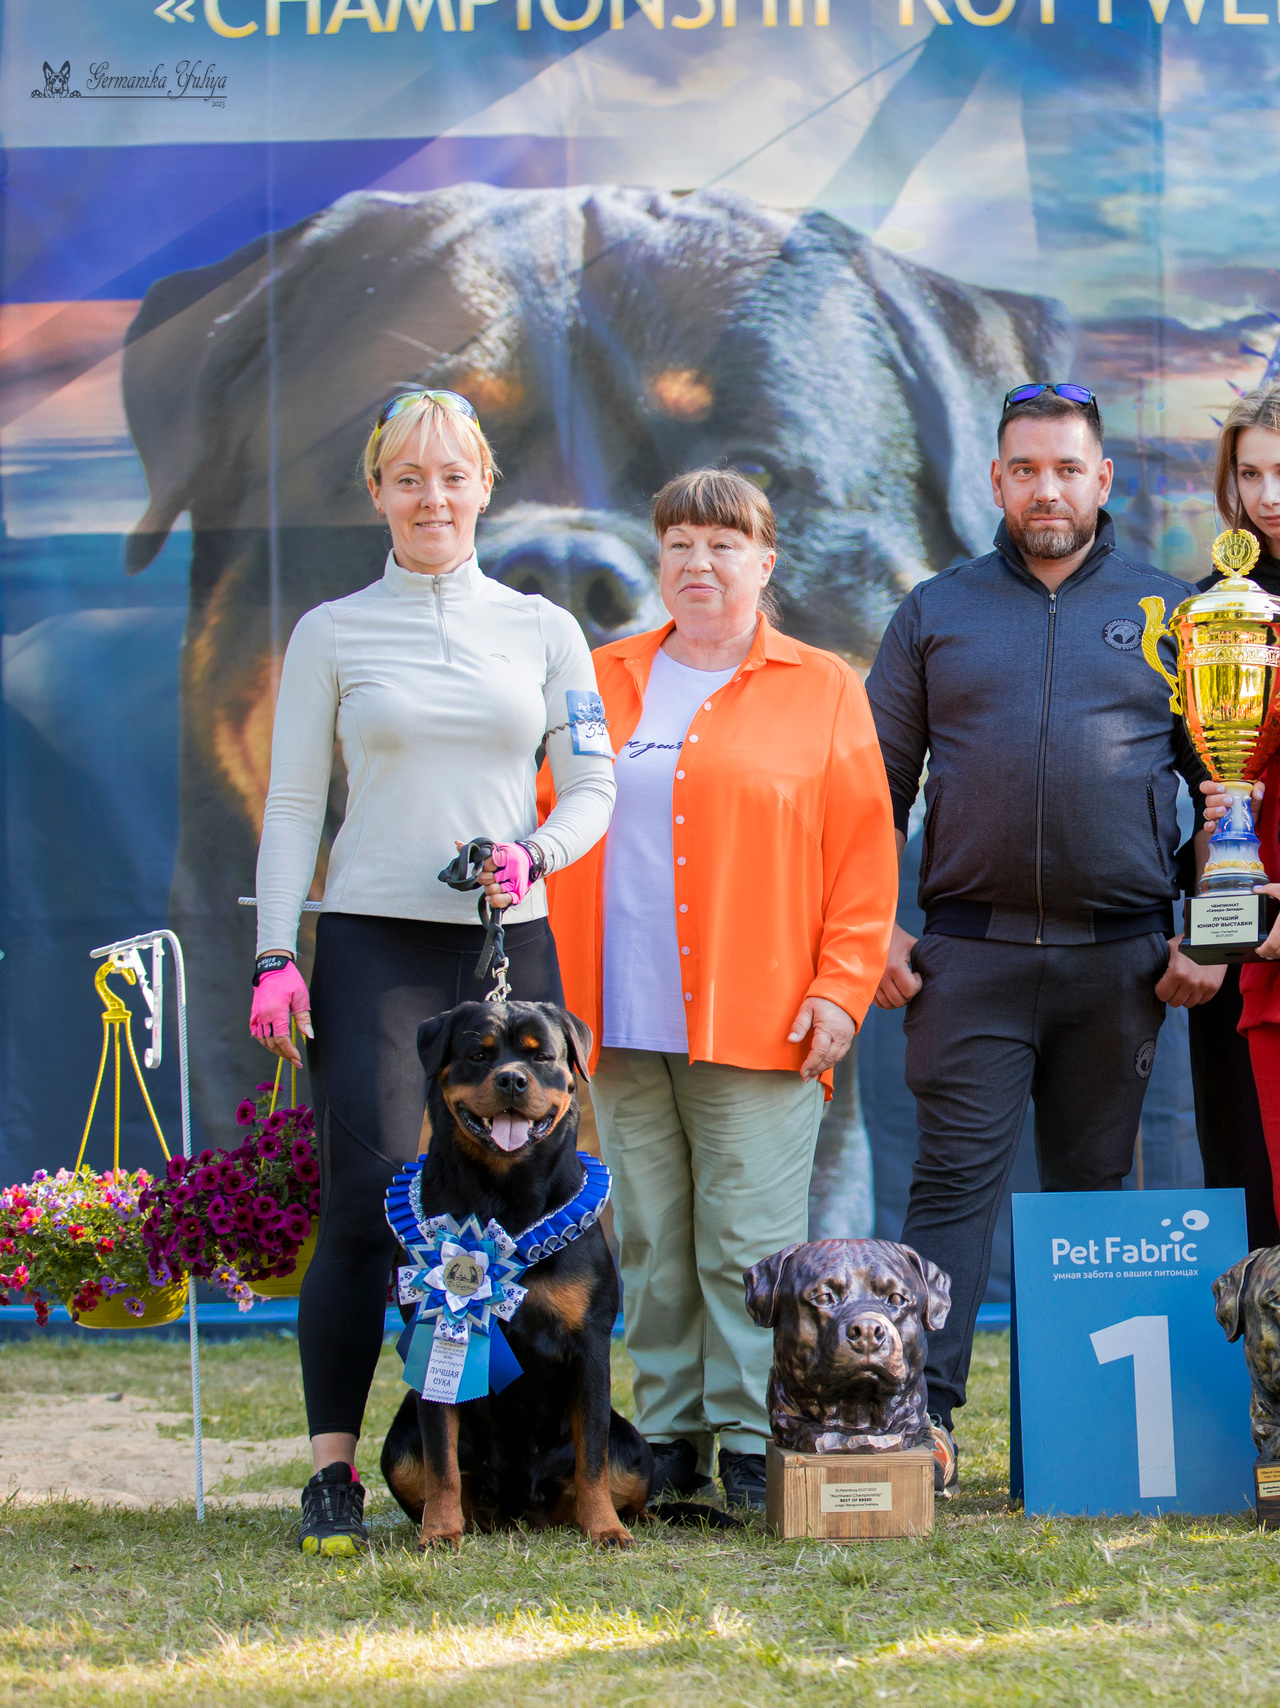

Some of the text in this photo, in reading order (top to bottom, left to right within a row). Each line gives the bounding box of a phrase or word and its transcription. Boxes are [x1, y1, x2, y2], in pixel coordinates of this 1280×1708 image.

[1052, 1237, 1198, 1265] Pet Fabric
[1053, 1272, 1081, 1281] умная
[1082, 1270, 1114, 1279] забота
[1123, 1270, 1152, 1278] ваших
[1154, 1269, 1199, 1279] питомцах
[429, 1367, 460, 1378] ЛУЧШАЯ
[432, 1377, 451, 1387] СУКА
[1089, 1314, 1177, 1499] 1
